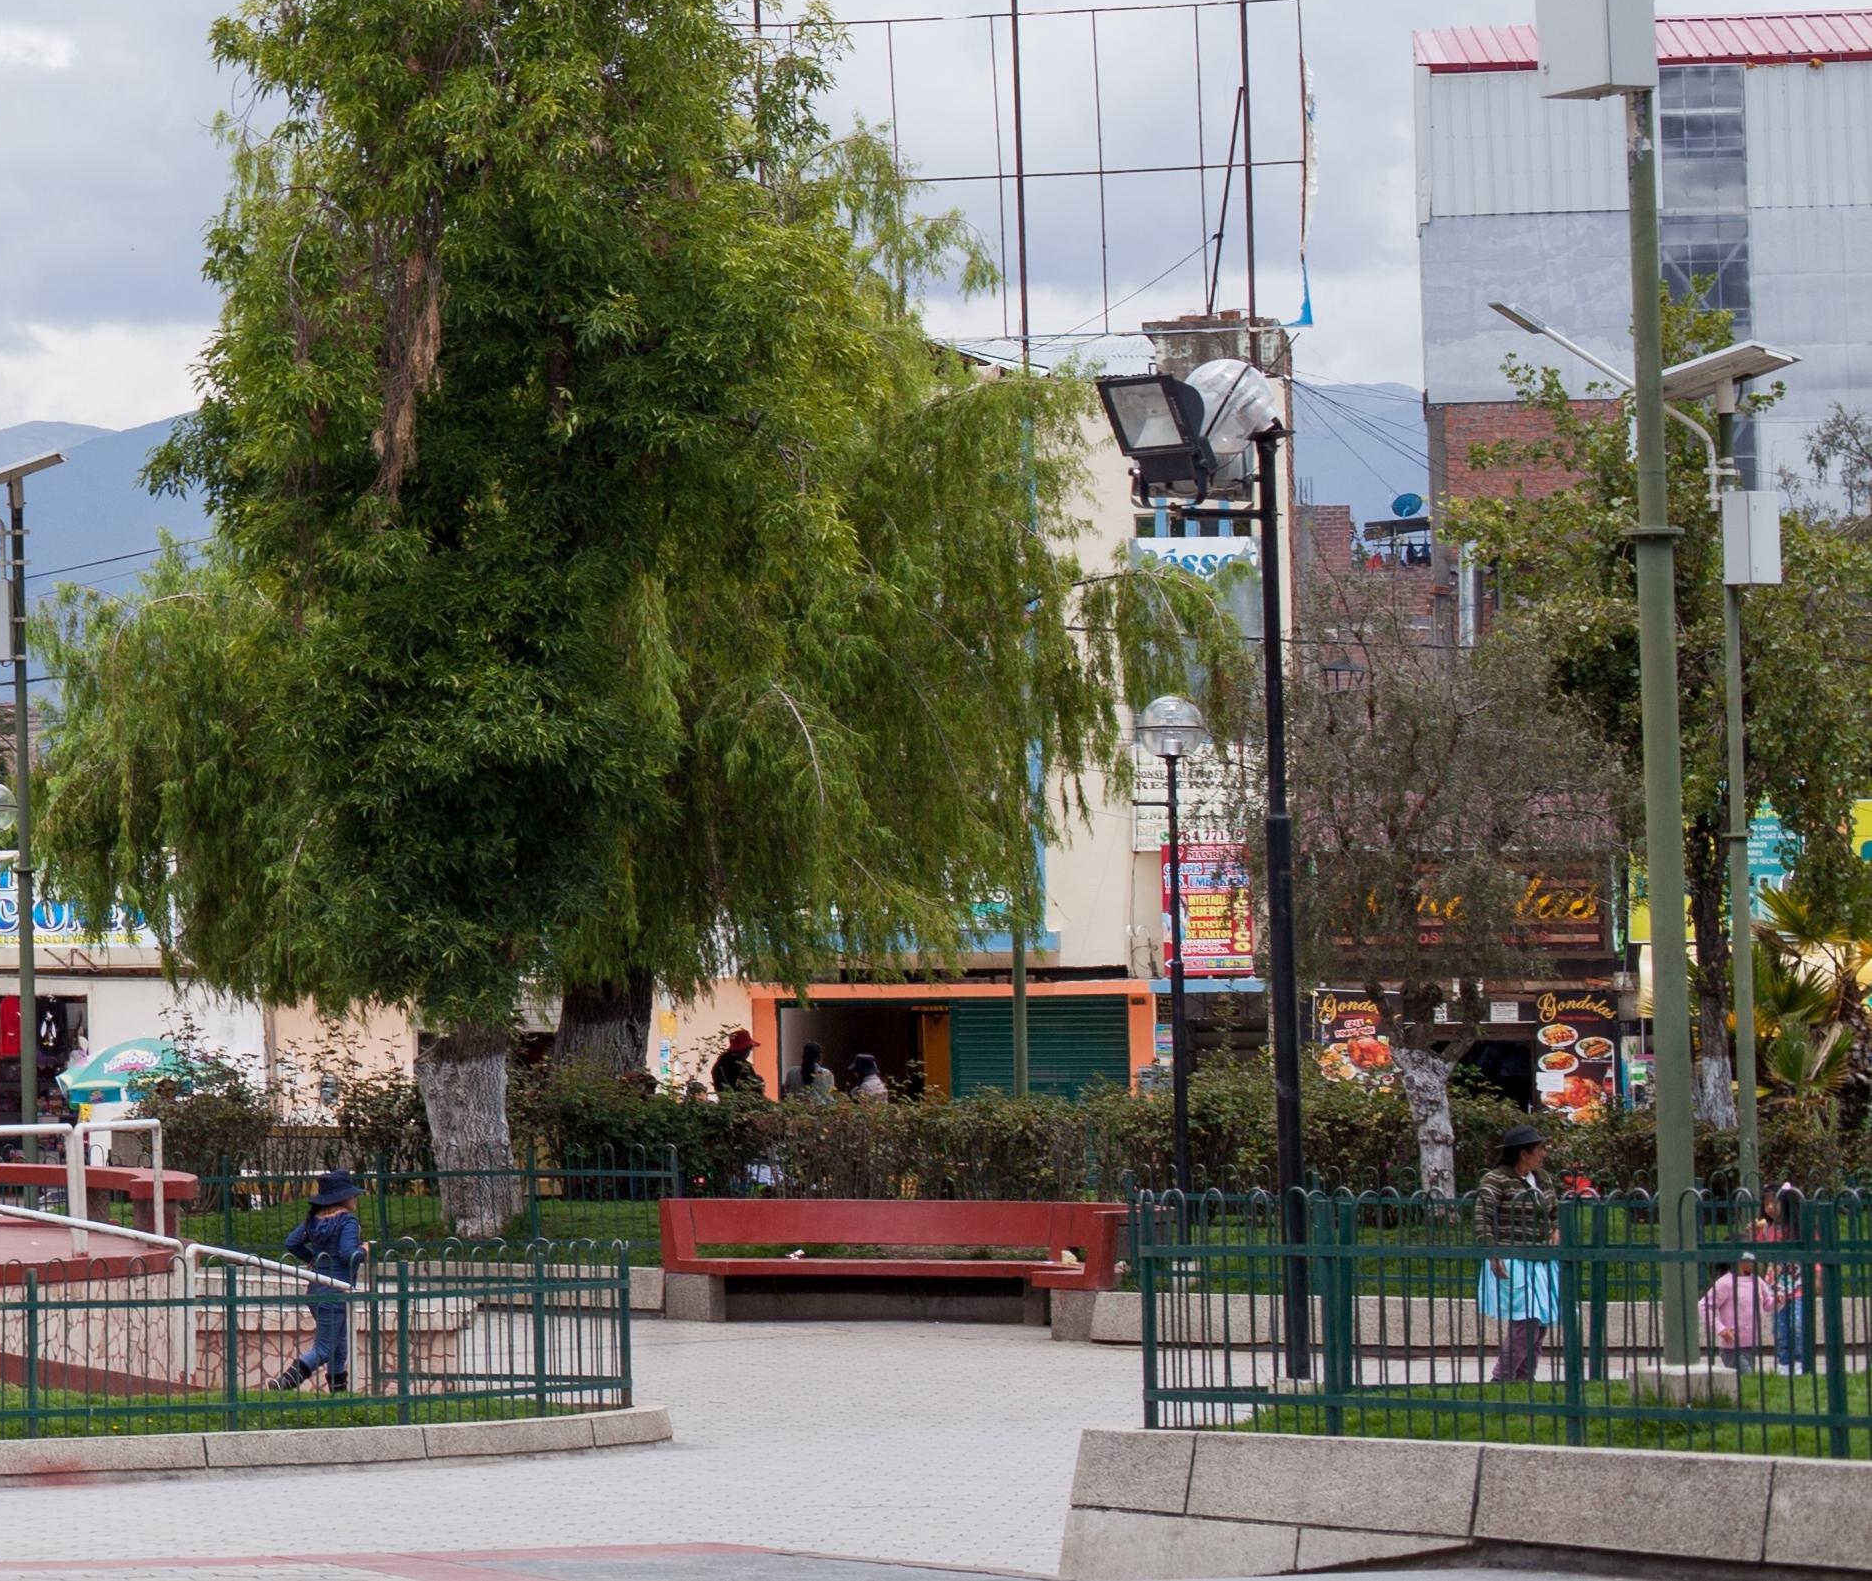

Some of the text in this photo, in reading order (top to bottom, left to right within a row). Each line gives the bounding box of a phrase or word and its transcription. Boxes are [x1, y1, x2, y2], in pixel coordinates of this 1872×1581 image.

[1163, 863, 1202, 874] GATIS
[1199, 929, 1233, 938] PARTOS
[1537, 992, 1618, 1022] Gondolas
